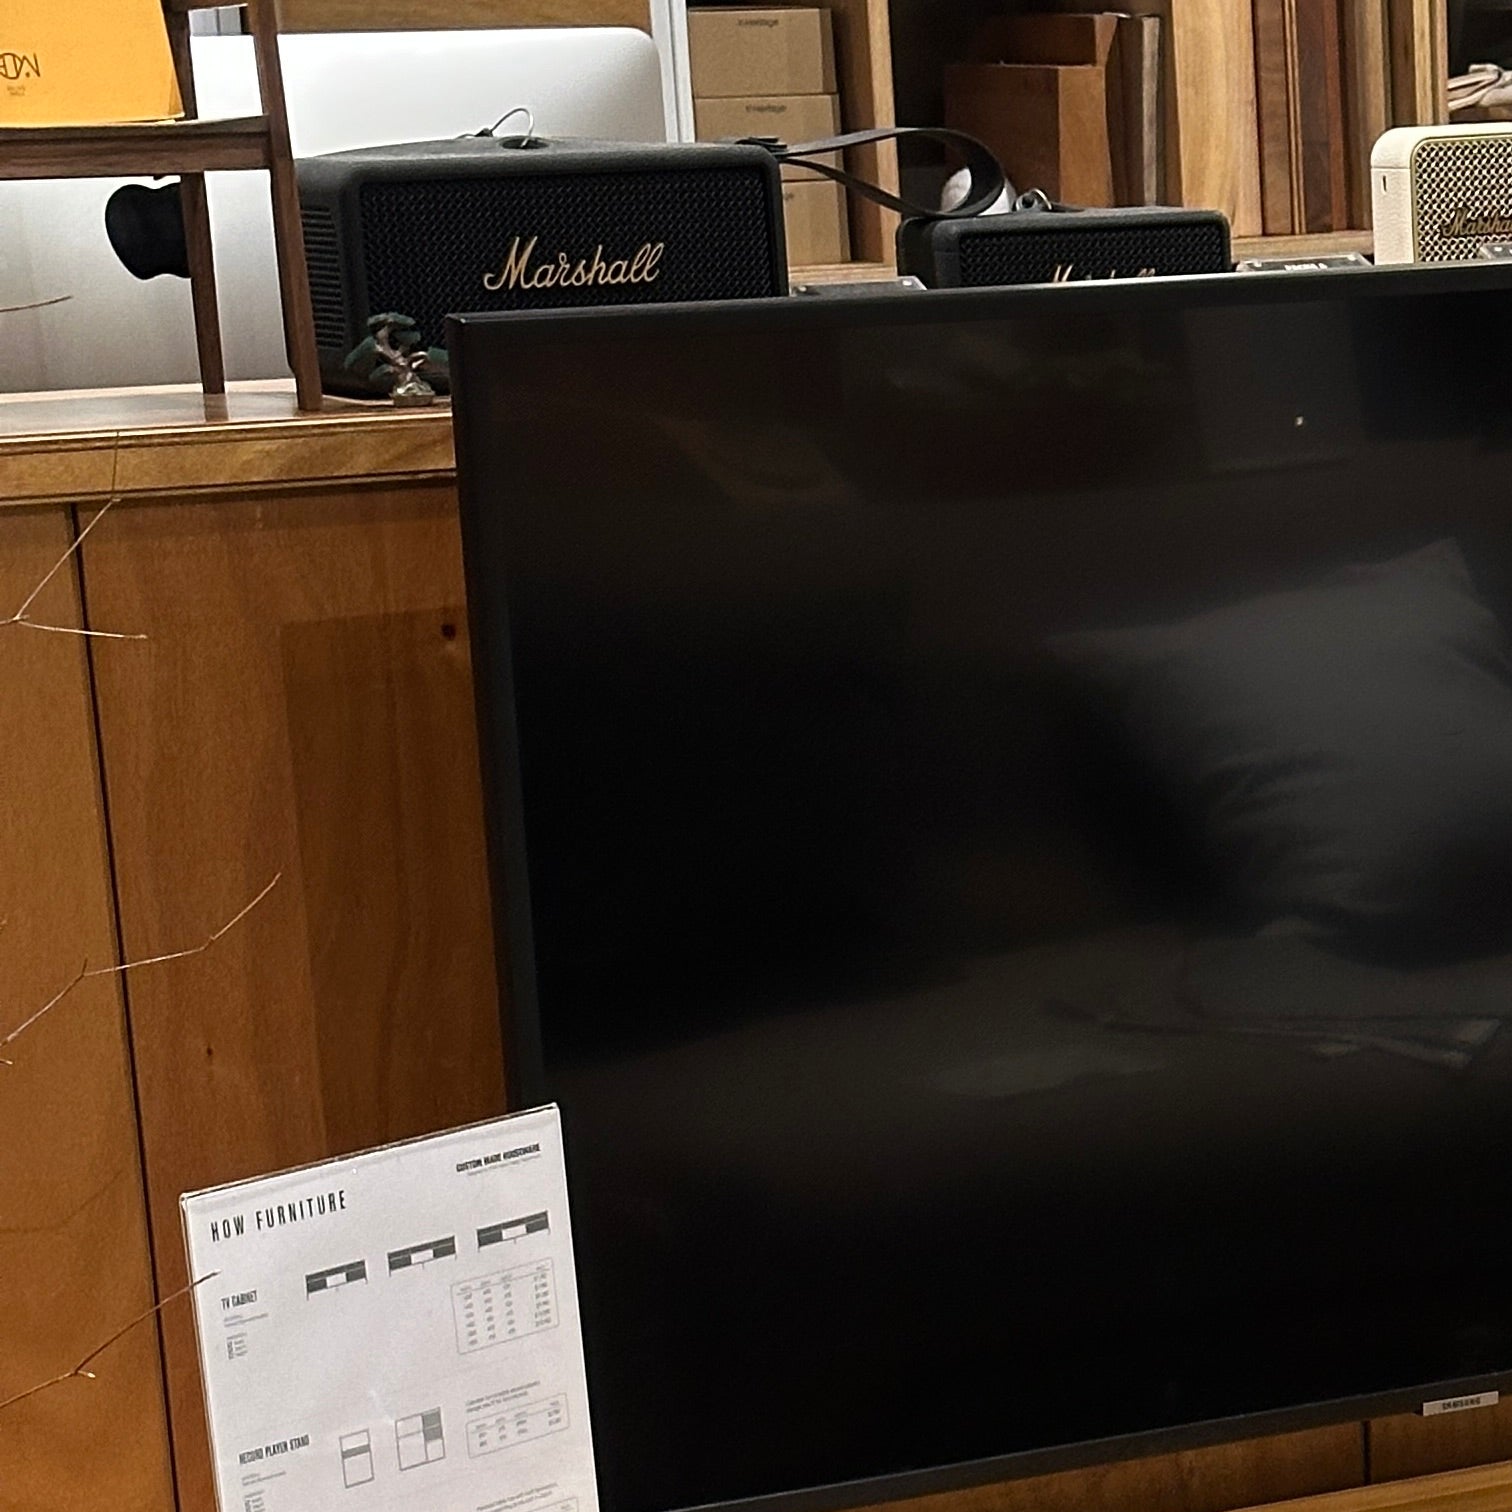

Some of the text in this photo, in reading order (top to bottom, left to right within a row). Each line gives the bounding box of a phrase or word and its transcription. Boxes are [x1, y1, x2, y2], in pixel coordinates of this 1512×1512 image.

[483, 235, 665, 291] Marshall
[210, 1190, 347, 1243] HOW FURNITURE
[221, 1298, 231, 1311] TV
